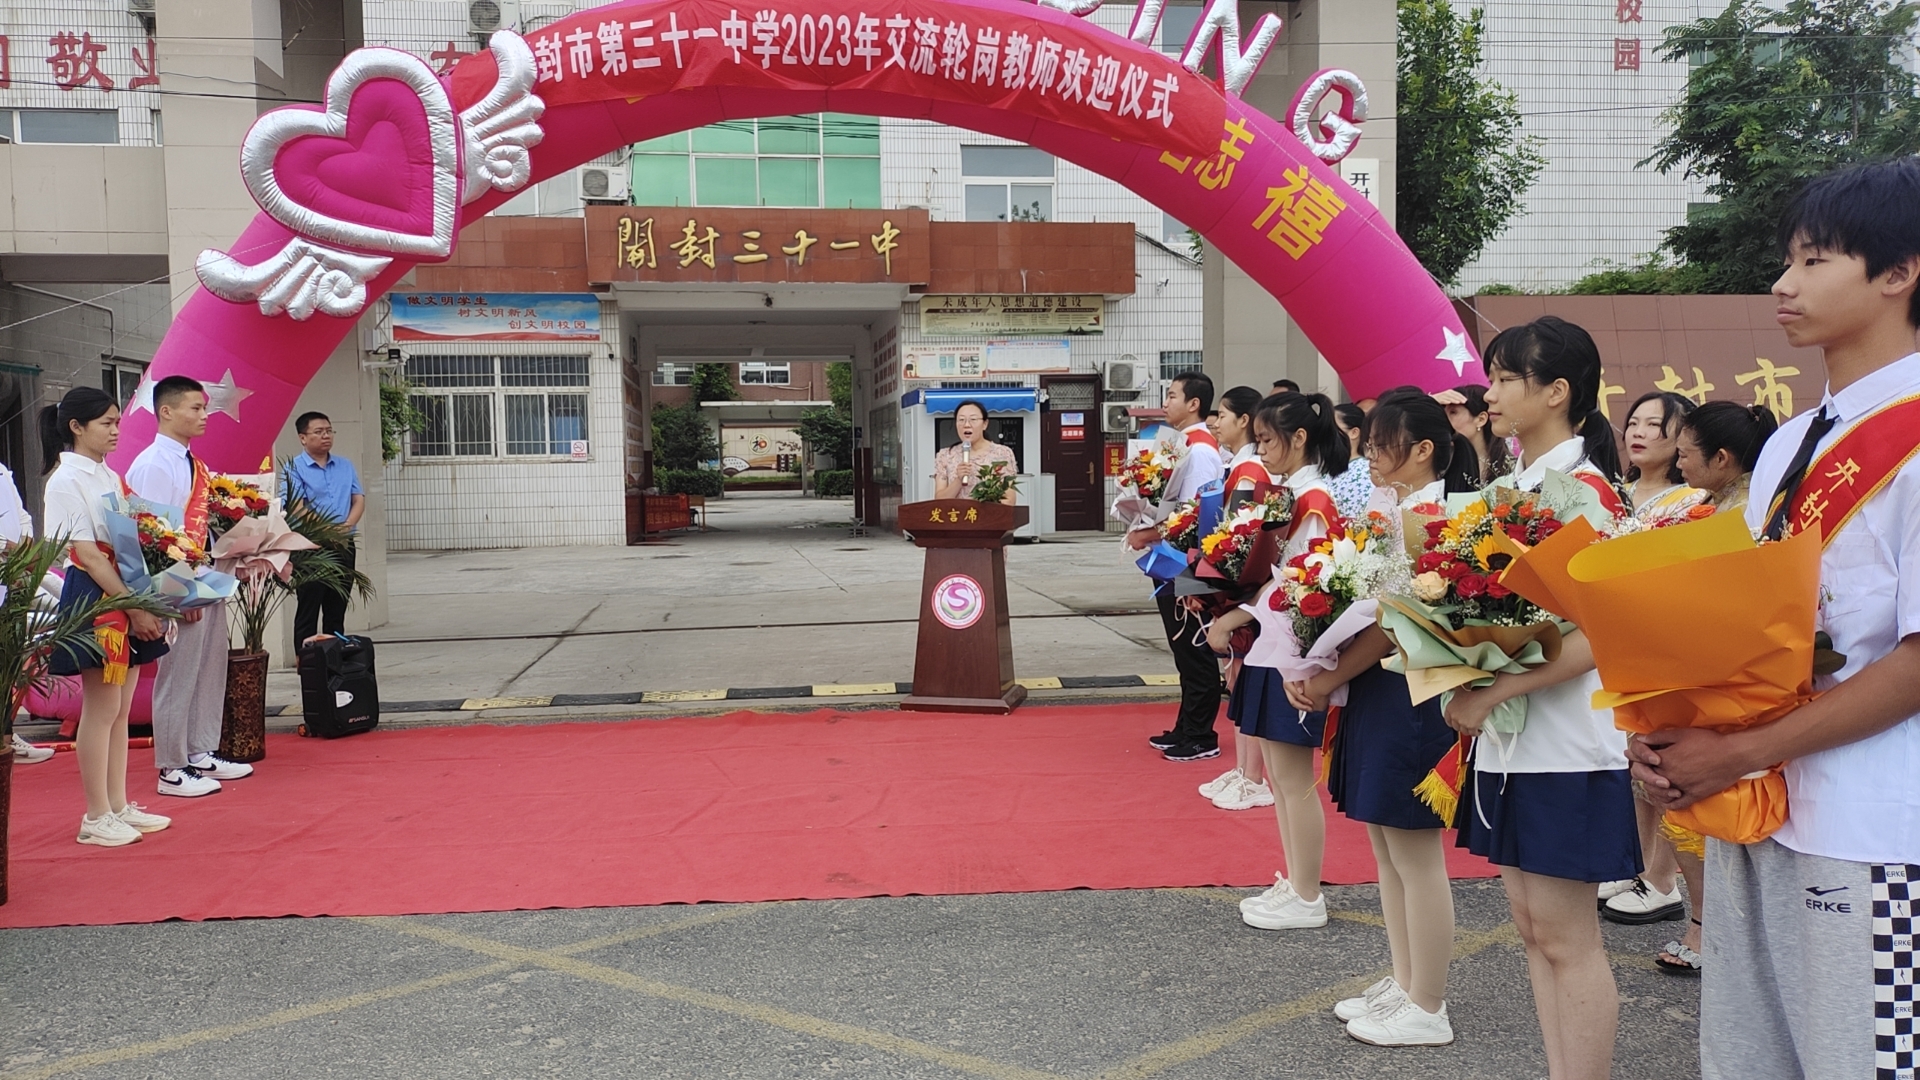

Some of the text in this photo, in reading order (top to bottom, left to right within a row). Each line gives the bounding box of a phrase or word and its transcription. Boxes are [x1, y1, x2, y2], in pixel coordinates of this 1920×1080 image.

[407, 295, 488, 306] 做文明学生
[943, 295, 1082, 308] 未成年人思想道德建设
[457, 308, 537, 318] 树文明新风
[508, 319, 586, 330] 创文明校园
[929, 507, 978, 524] 发言席
[1886, 870, 1906, 878] ERKE
[1805, 898, 1851, 913] ERKE
[1893, 939, 1912, 947] ERKE
[1894, 1006, 1913, 1014] ERKE
